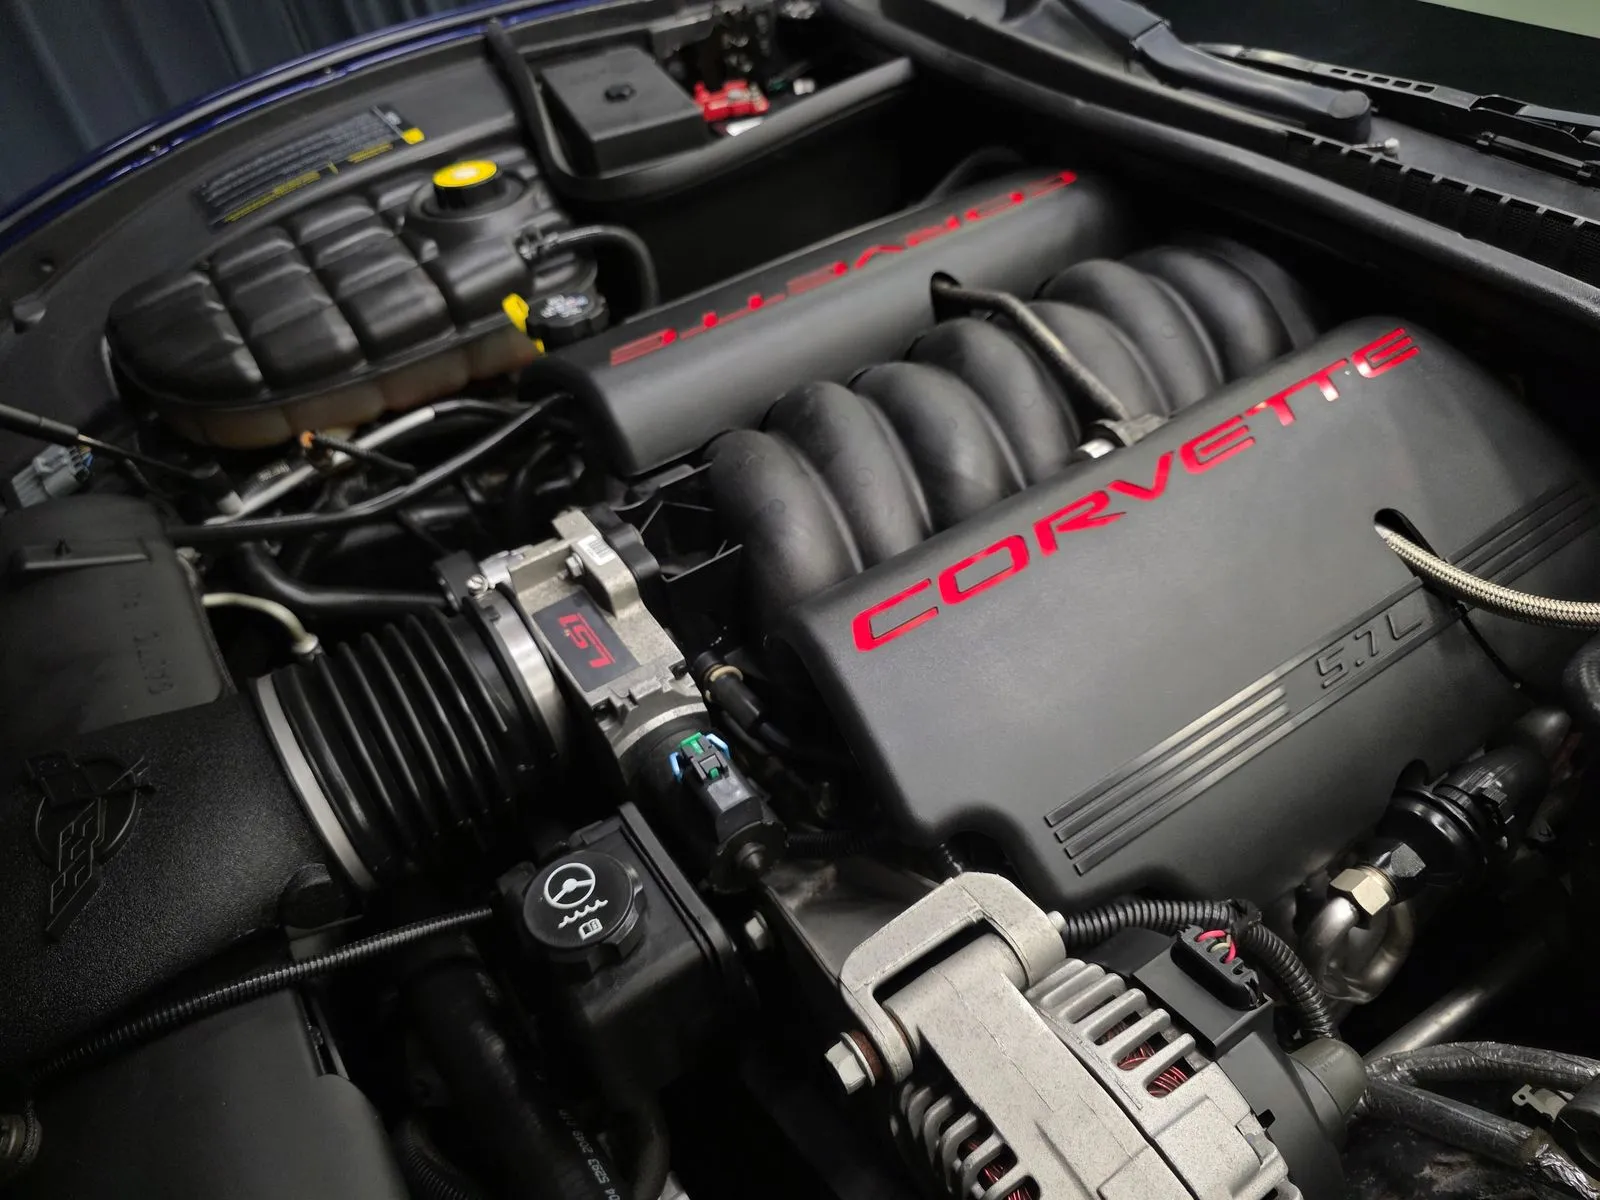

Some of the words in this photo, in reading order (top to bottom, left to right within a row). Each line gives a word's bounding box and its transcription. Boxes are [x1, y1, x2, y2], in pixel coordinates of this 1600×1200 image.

[610, 170, 1078, 366] CORVETTE
[850, 326, 1420, 653] CORVETTE
[559, 612, 615, 668] LS1
[1316, 609, 1424, 690] 5.7L
